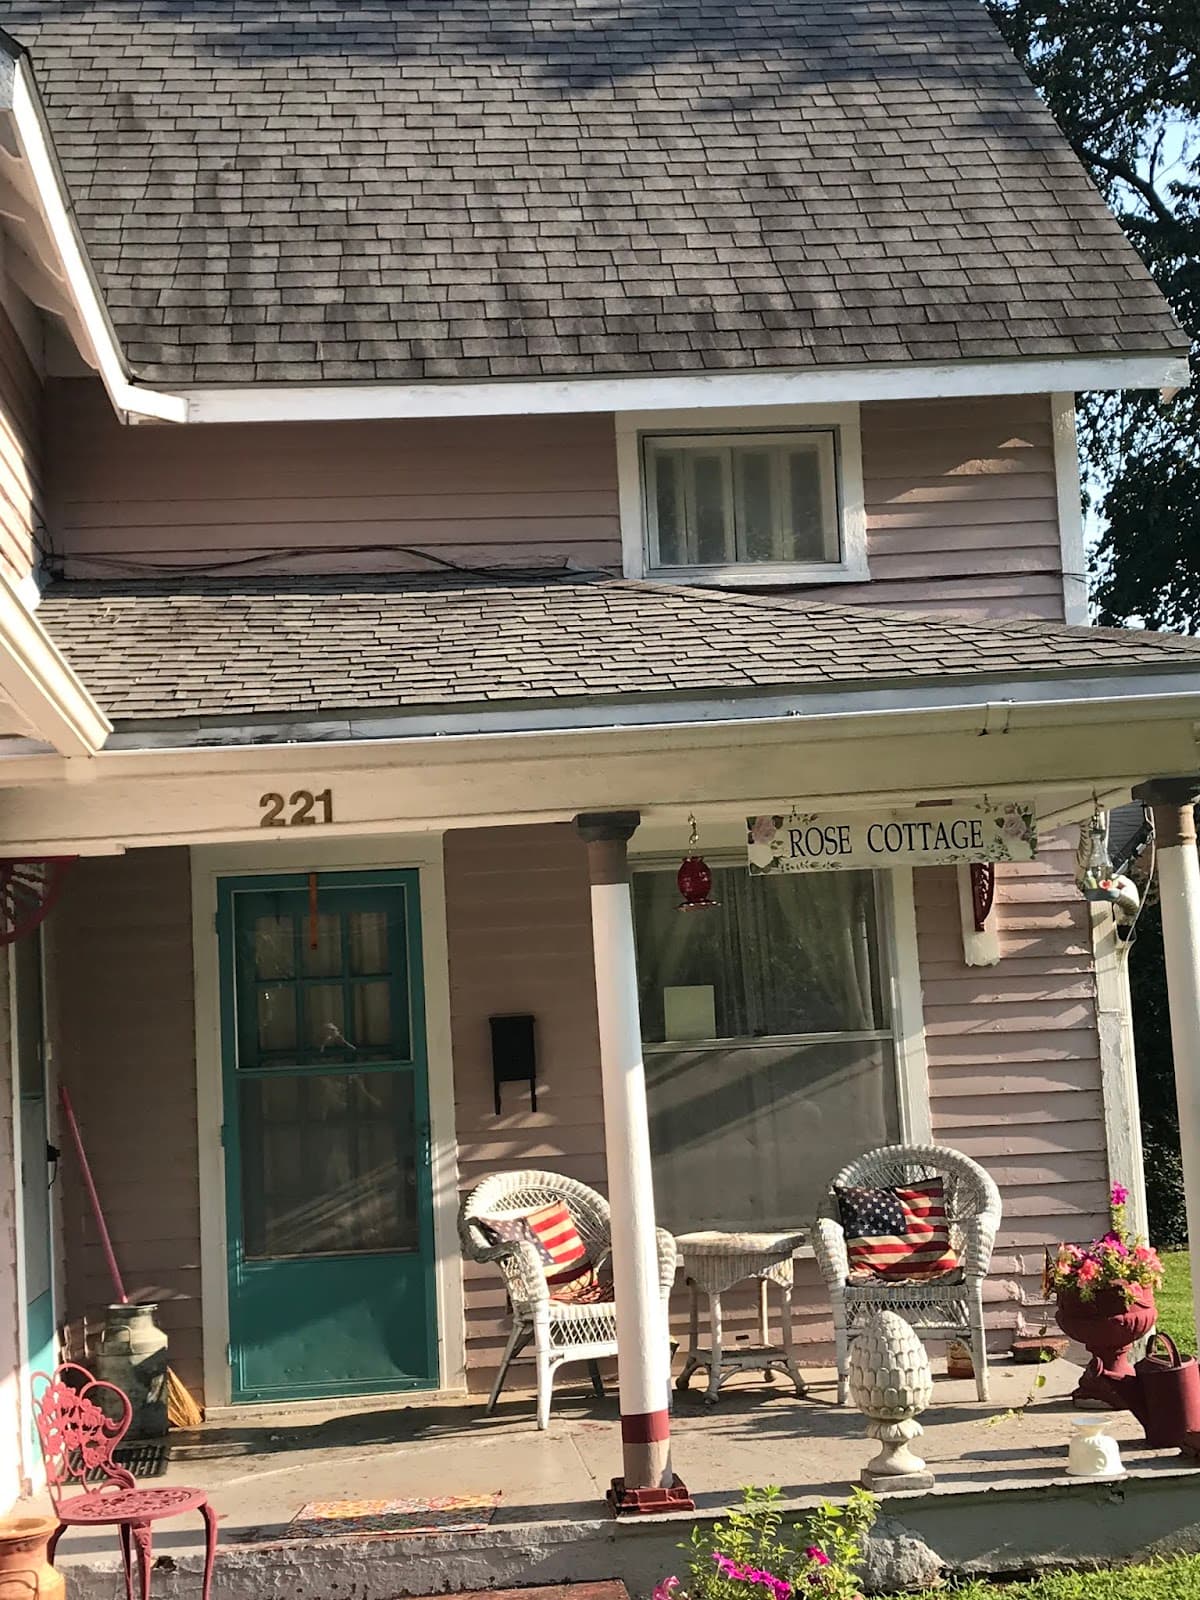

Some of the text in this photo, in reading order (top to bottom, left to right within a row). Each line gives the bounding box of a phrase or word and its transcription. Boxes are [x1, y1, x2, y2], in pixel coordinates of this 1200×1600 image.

[259, 788, 333, 827] 221
[789, 820, 984, 858] ROSE COTTAGE
